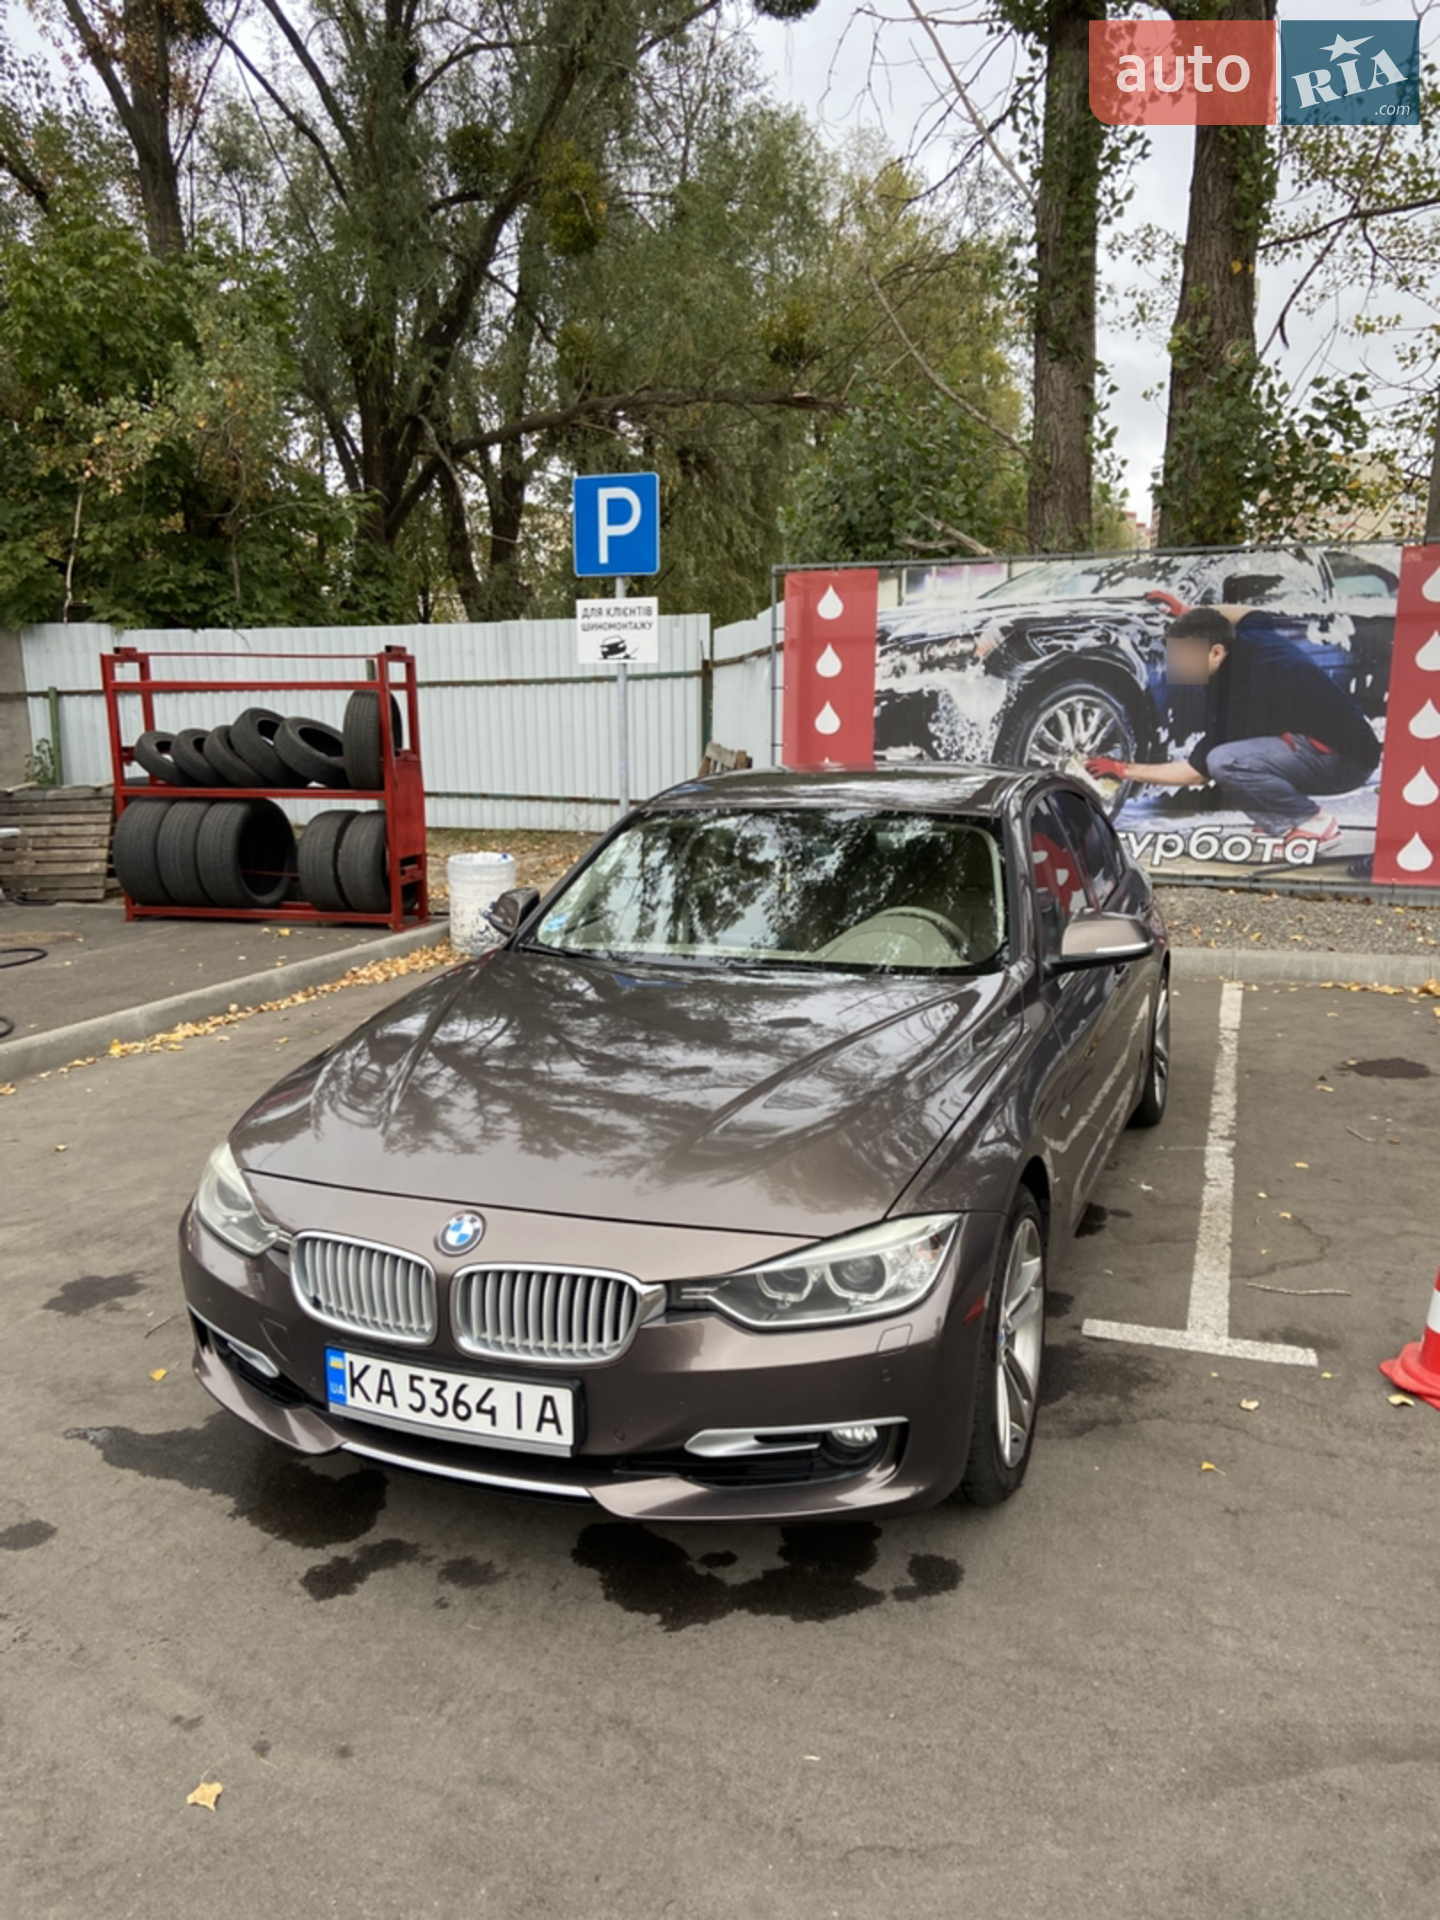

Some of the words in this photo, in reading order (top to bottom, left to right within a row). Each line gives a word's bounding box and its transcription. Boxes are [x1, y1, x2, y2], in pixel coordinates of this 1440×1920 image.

[597, 486, 642, 565] P
[581, 607, 603, 619] ДЛЯ
[581, 621, 653, 632] ШИНОМОНТАЖУ
[1116, 825, 1320, 867] урбота
[329, 1382, 345, 1396] UA
[348, 1360, 398, 1409] KA
[407, 1373, 497, 1427] 5364
